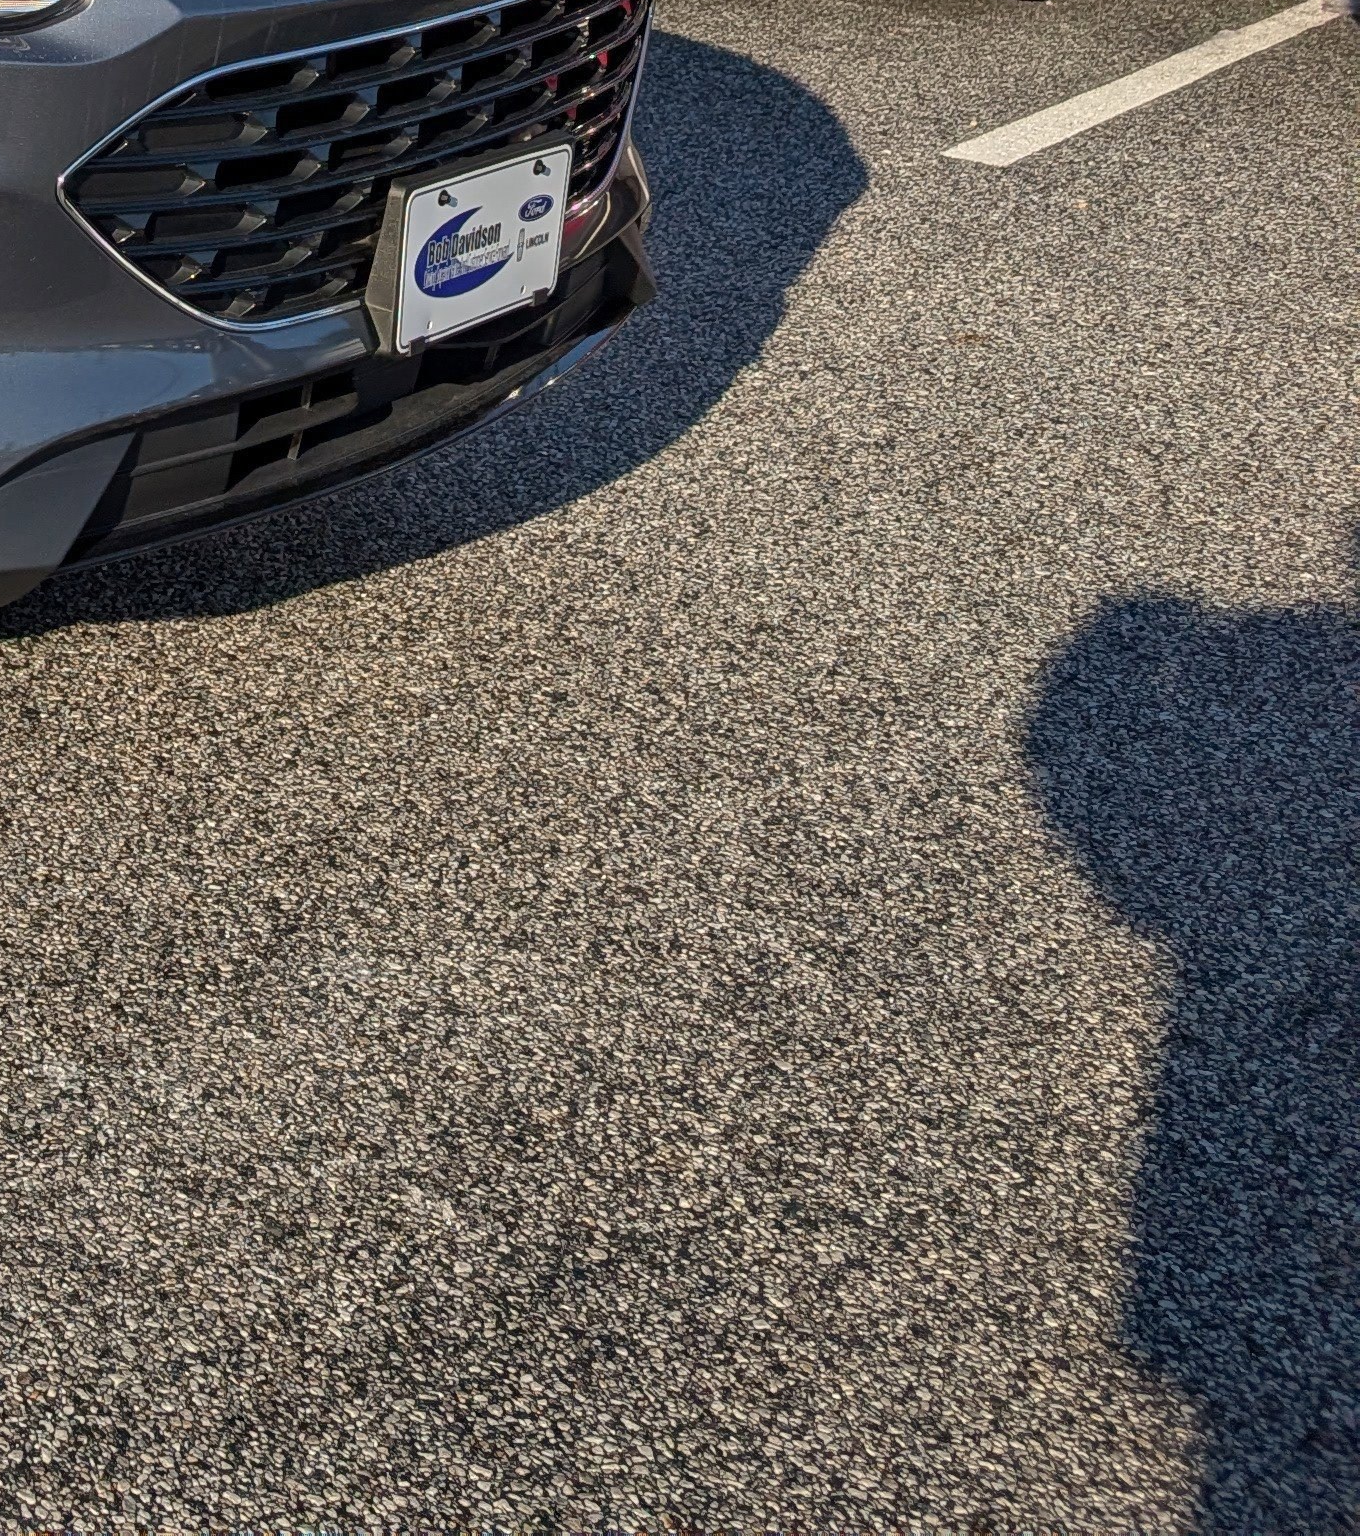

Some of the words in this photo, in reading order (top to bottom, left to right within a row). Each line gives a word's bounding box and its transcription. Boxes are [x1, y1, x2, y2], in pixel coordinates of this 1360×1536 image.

[523, 197, 550, 219] Ford
[427, 235, 451, 267] Bob
[451, 221, 502, 256] Davidson
